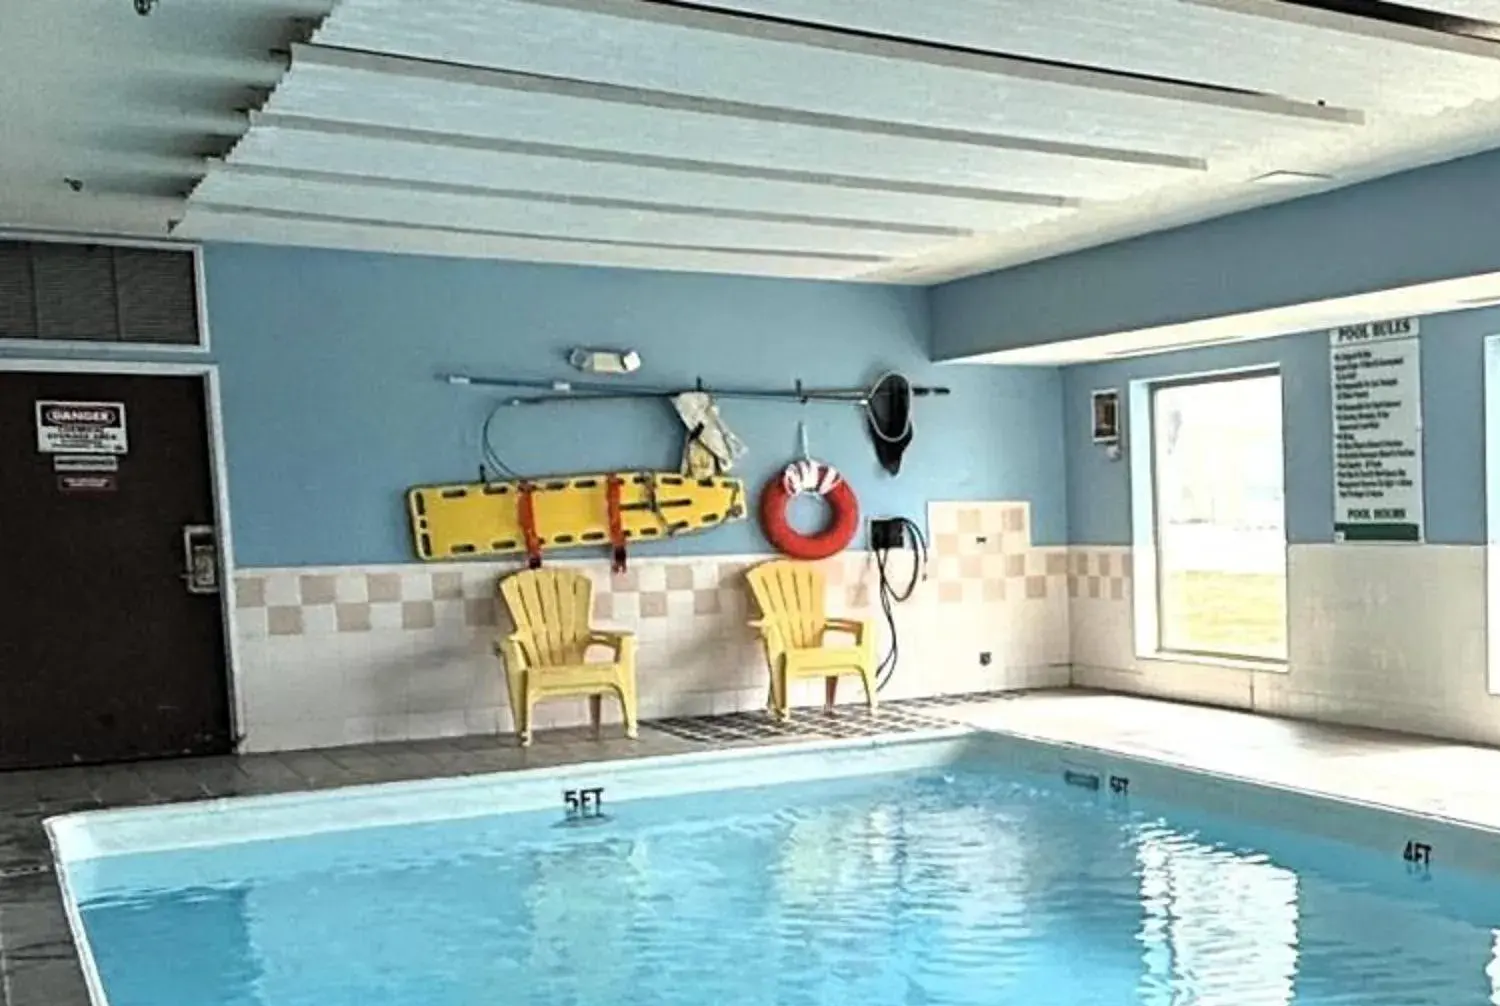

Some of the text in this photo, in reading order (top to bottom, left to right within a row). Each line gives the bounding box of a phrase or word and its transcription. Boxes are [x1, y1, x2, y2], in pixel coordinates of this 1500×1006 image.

[1339, 318, 1410, 341] POOL RULES
[563, 787, 605, 818] 5FT
[1403, 840, 1432, 864] 4FT
